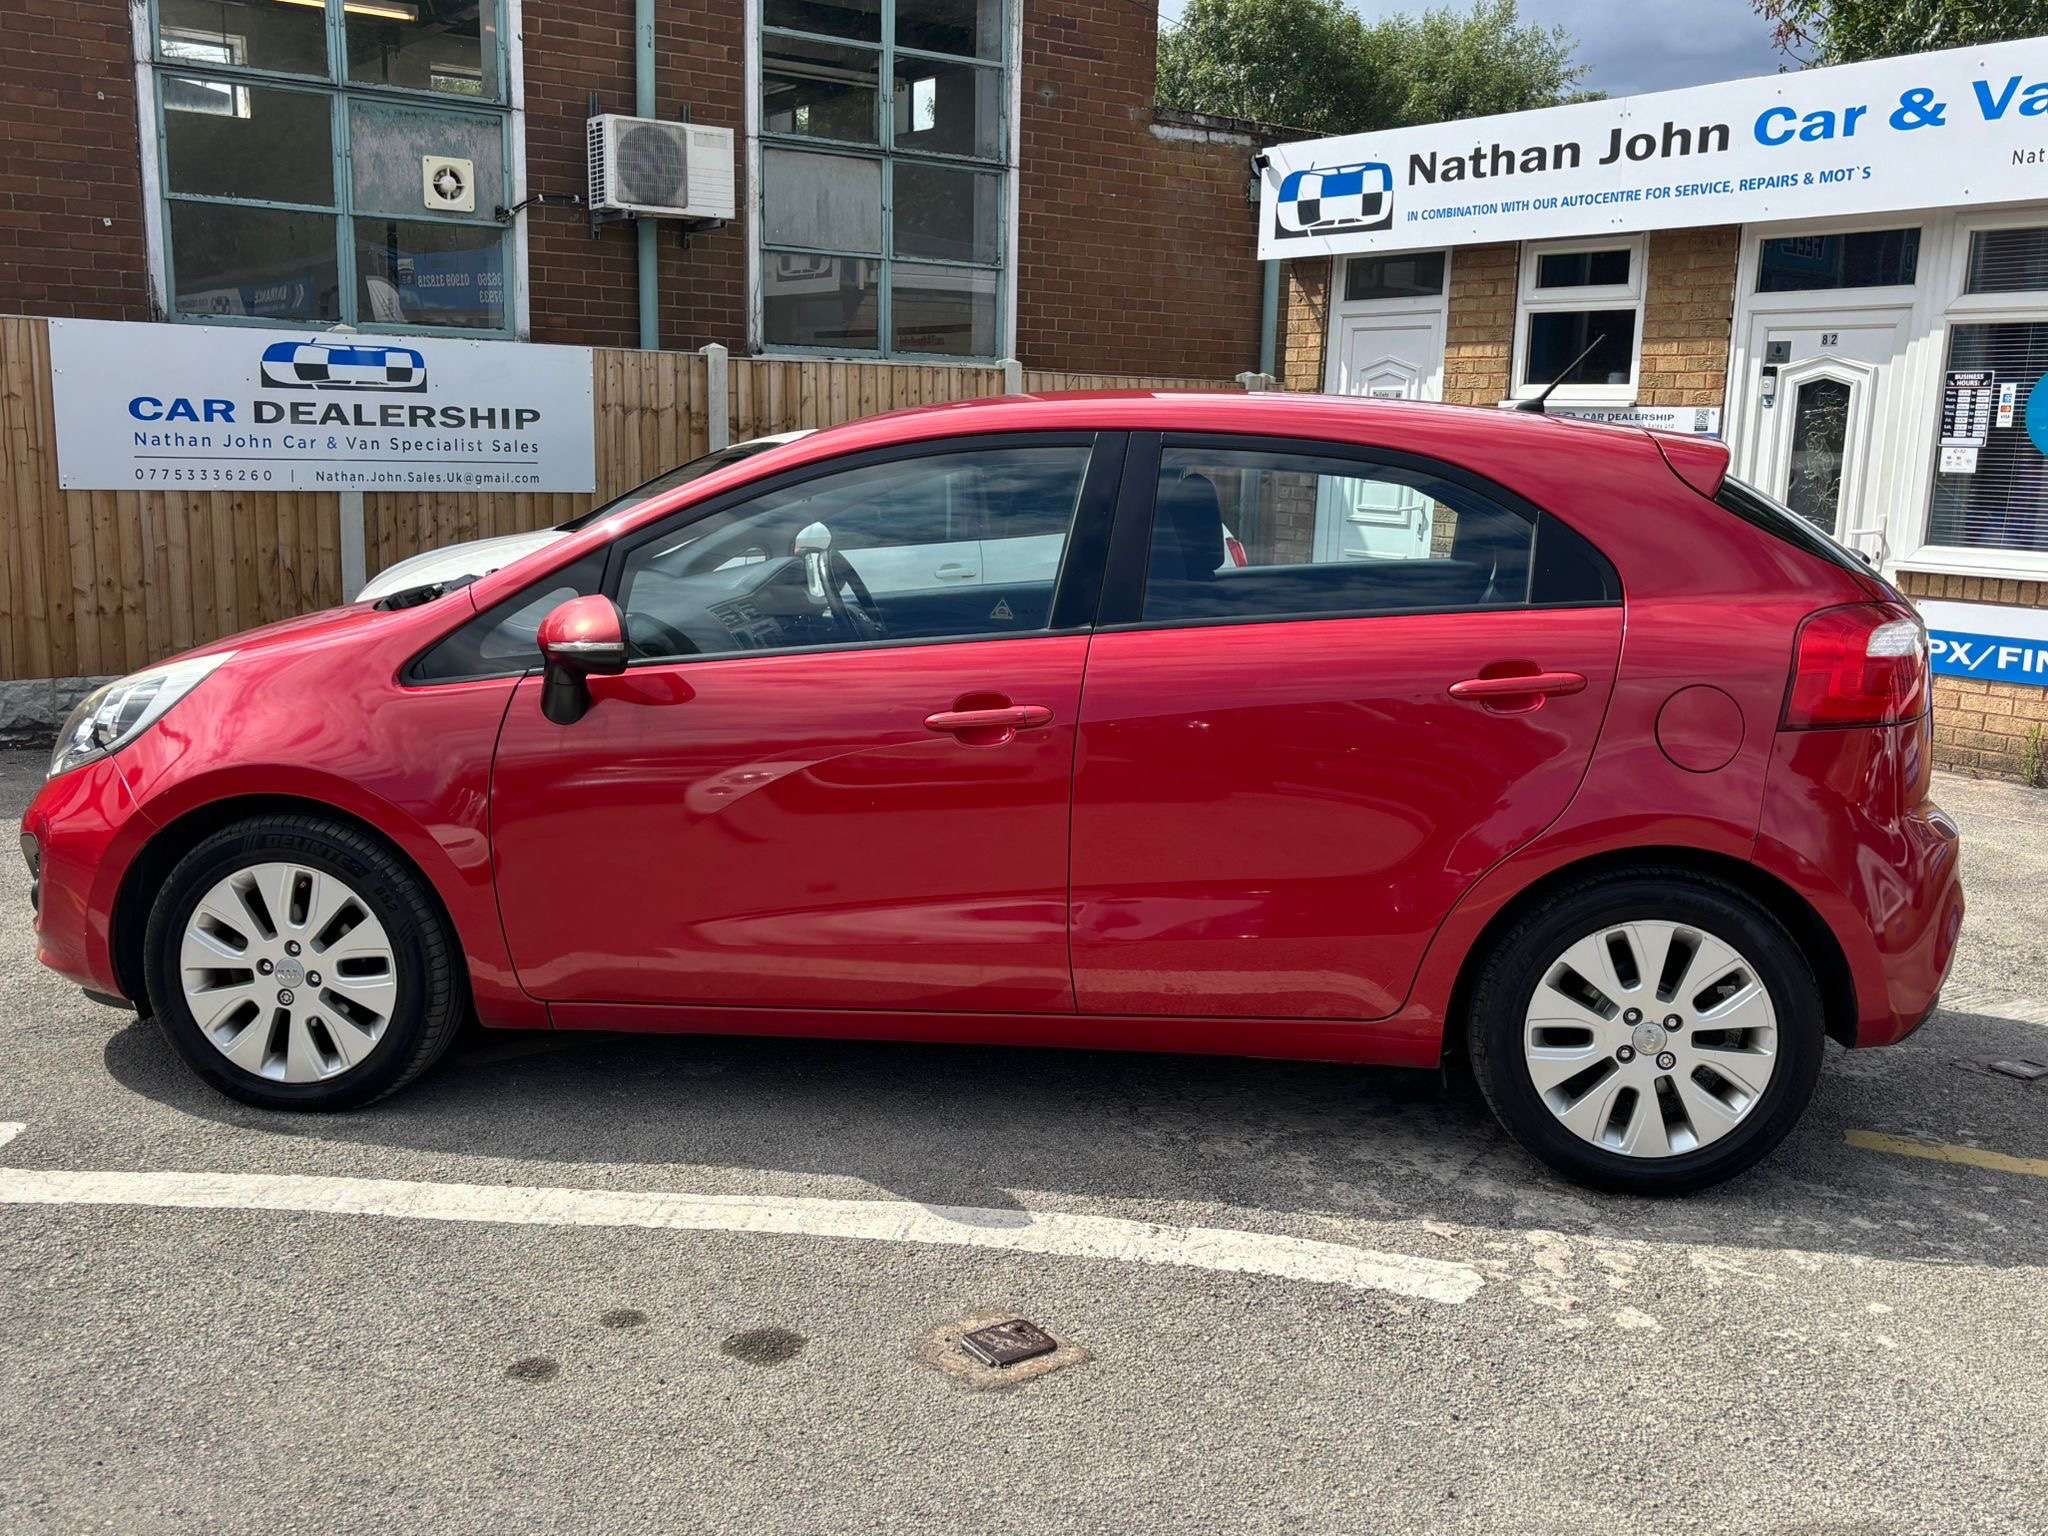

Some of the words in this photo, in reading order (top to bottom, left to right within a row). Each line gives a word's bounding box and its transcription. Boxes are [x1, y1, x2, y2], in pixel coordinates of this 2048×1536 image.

[1408, 142, 1581, 186] Nathan
[1598, 121, 1730, 165] John
[1753, 105, 1868, 146] Car
[1888, 87, 1947, 131] &
[1406, 211, 1419, 222] IN
[1421, 202, 1498, 220] COMBINATION
[1501, 199, 1530, 215] WITH
[1533, 197, 1558, 211] OUR
[1560, 188, 1642, 207] AUTOCENTRE
[1645, 185, 1671, 200] FOR
[1674, 180, 1734, 198] SERVICE,
[1739, 173, 1798, 192] REPAIRS
[1803, 172, 1815, 185] &
[128, 396, 236, 423] CAR
[253, 400, 541, 430] DEALERSHIP
[1583, 412, 1605, 421] CAR
[1608, 412, 1675, 422] DEALERSHIP
[134, 431, 212, 448] Nathan
[223, 434, 273, 449] John
[283, 435, 317, 449] Car
[327, 436, 338, 450] &
[346, 436, 380, 451] Van
[390, 438, 483, 454] Specialist
[492, 440, 539, 453] Sales
[135, 468, 272, 481] 07753336260
[315, 471, 540, 485] Nathan.John.Sales.Uk@gmail.com
